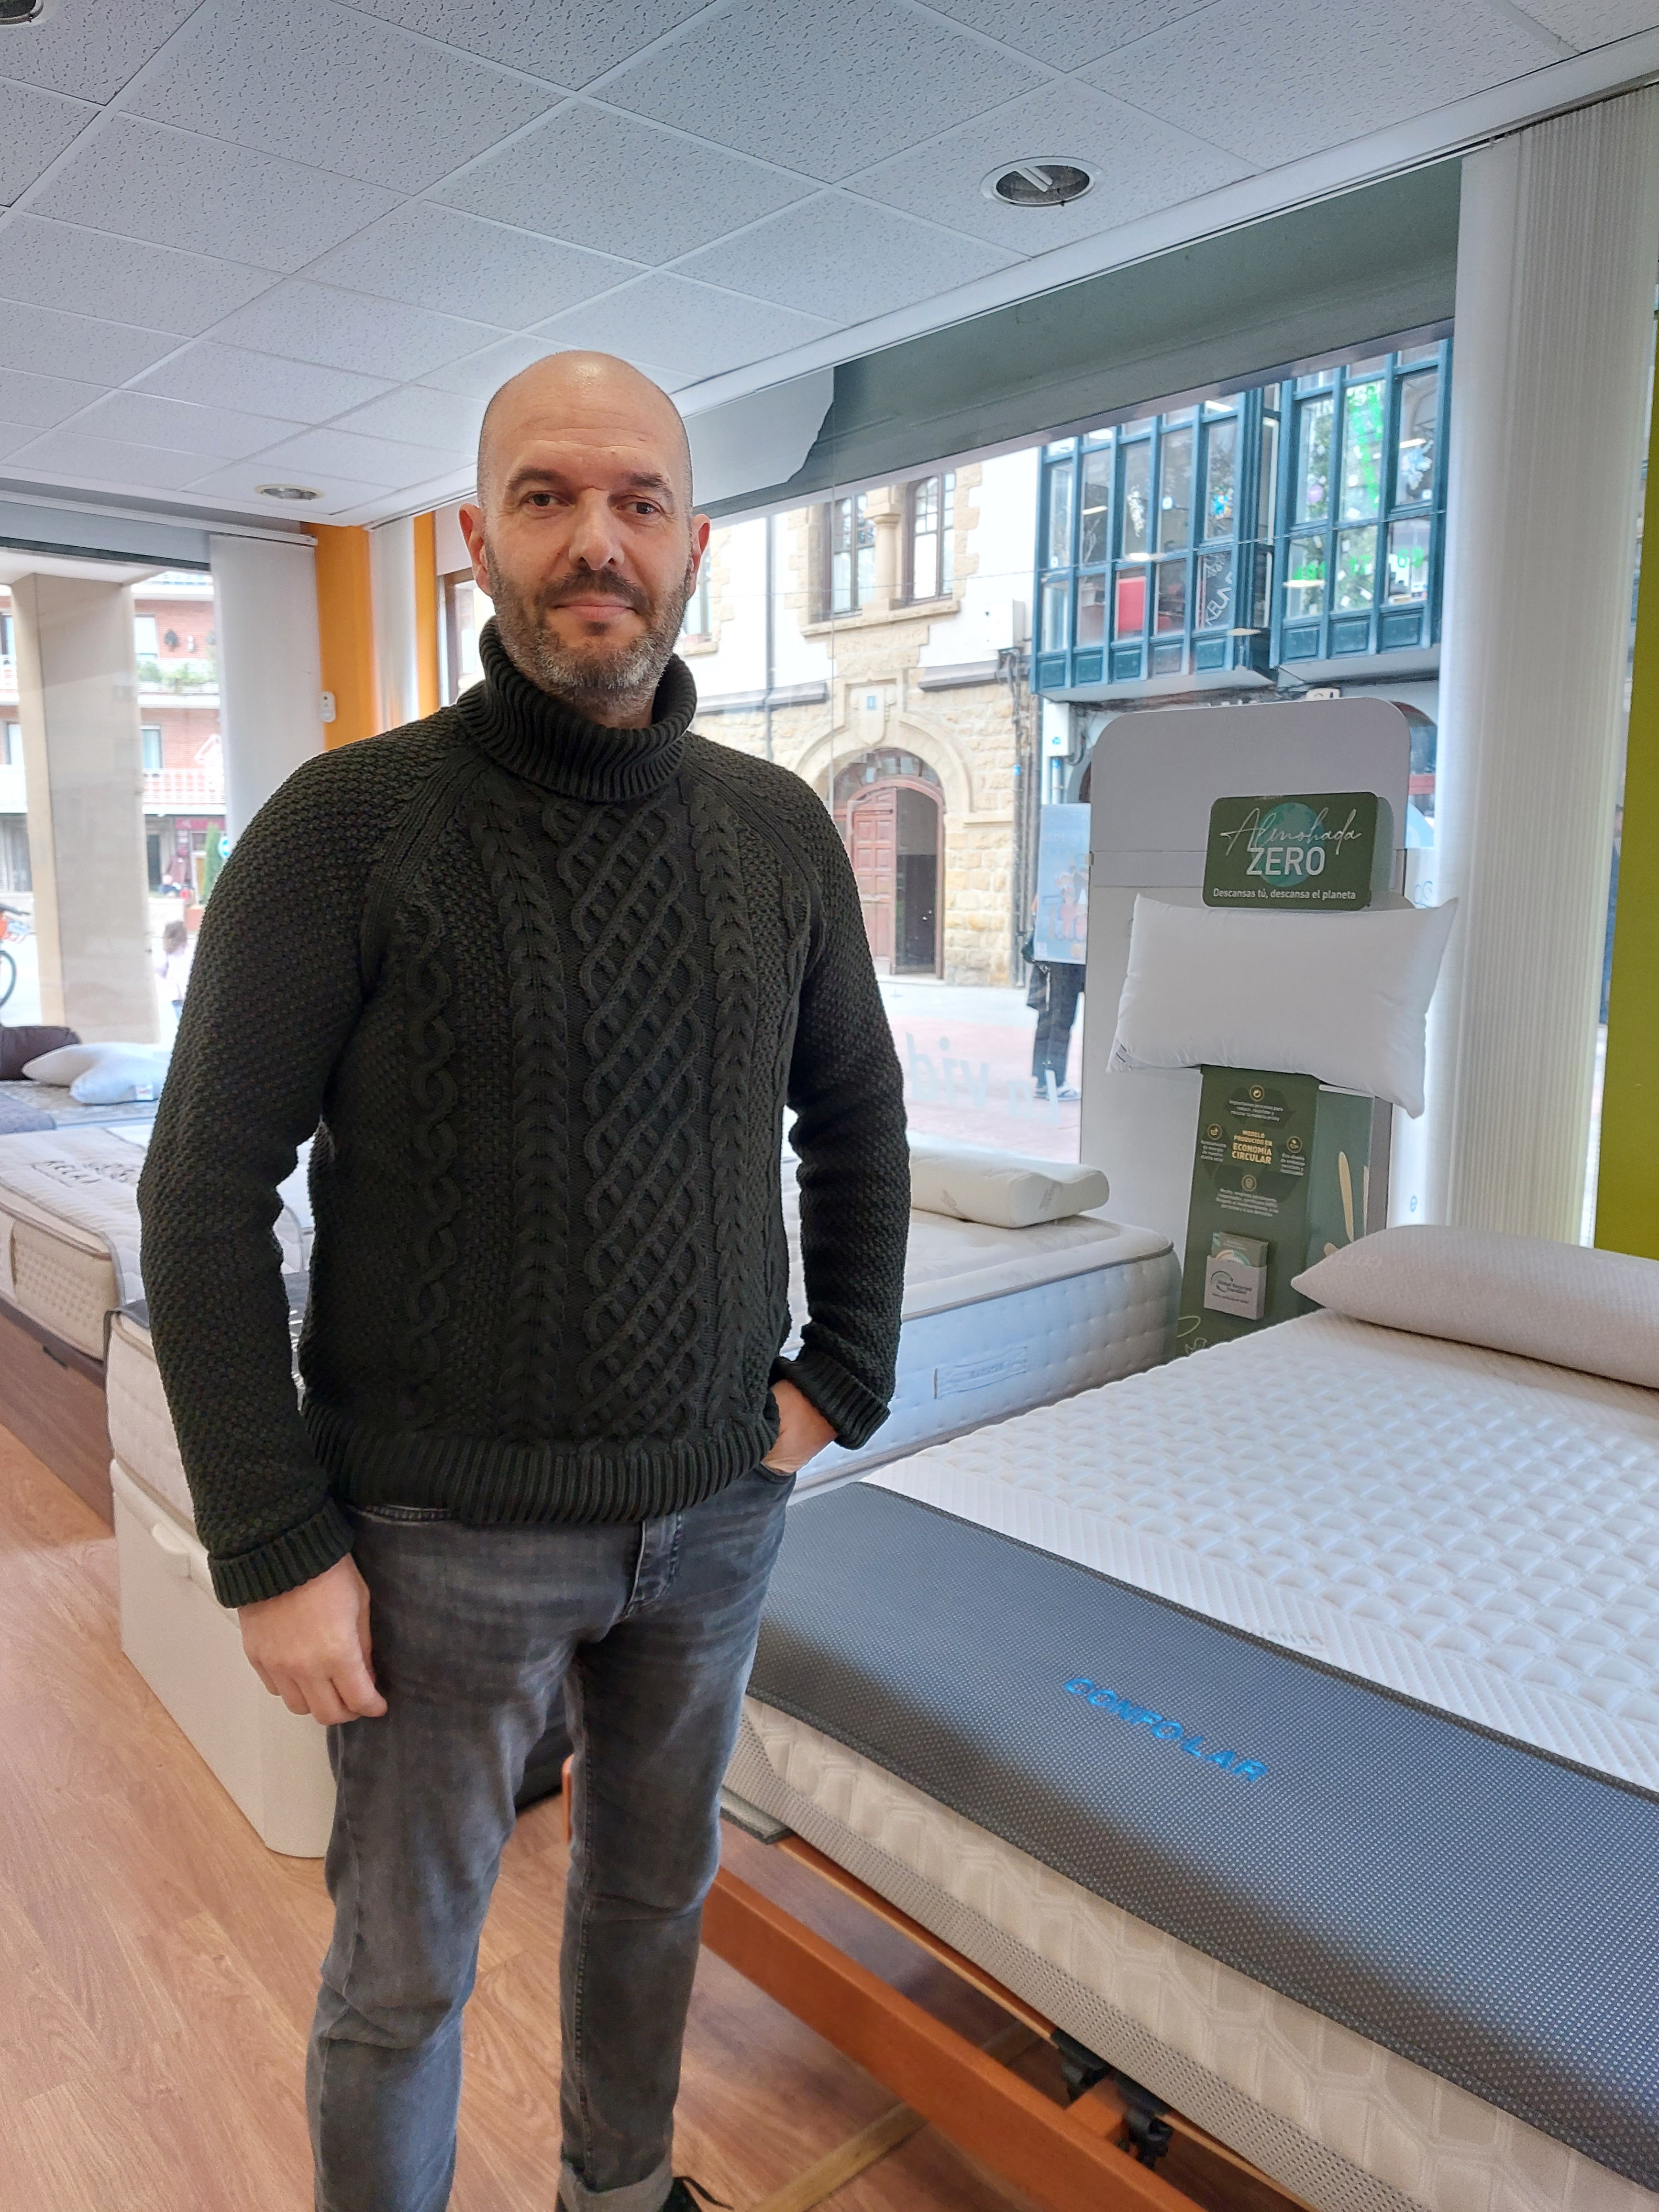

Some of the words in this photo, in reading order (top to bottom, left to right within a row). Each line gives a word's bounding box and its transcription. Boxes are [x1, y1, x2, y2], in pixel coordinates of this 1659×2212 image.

[1220, 807, 1362, 856] Almohada
[1246, 846, 1326, 875] ZERO
[1213, 888, 1255, 898] Descansas
[1258, 888, 1268, 898] tú,
[1270, 889, 1310, 899] descansa
[1312, 890, 1320, 899] el
[1322, 890, 1357, 901] planeta
[1232, 1150, 1272, 1164] CIRCULAR
[1233, 1142, 1272, 1156] ECONOMÍA
[1064, 1677, 1269, 1782] CONFOLAR
